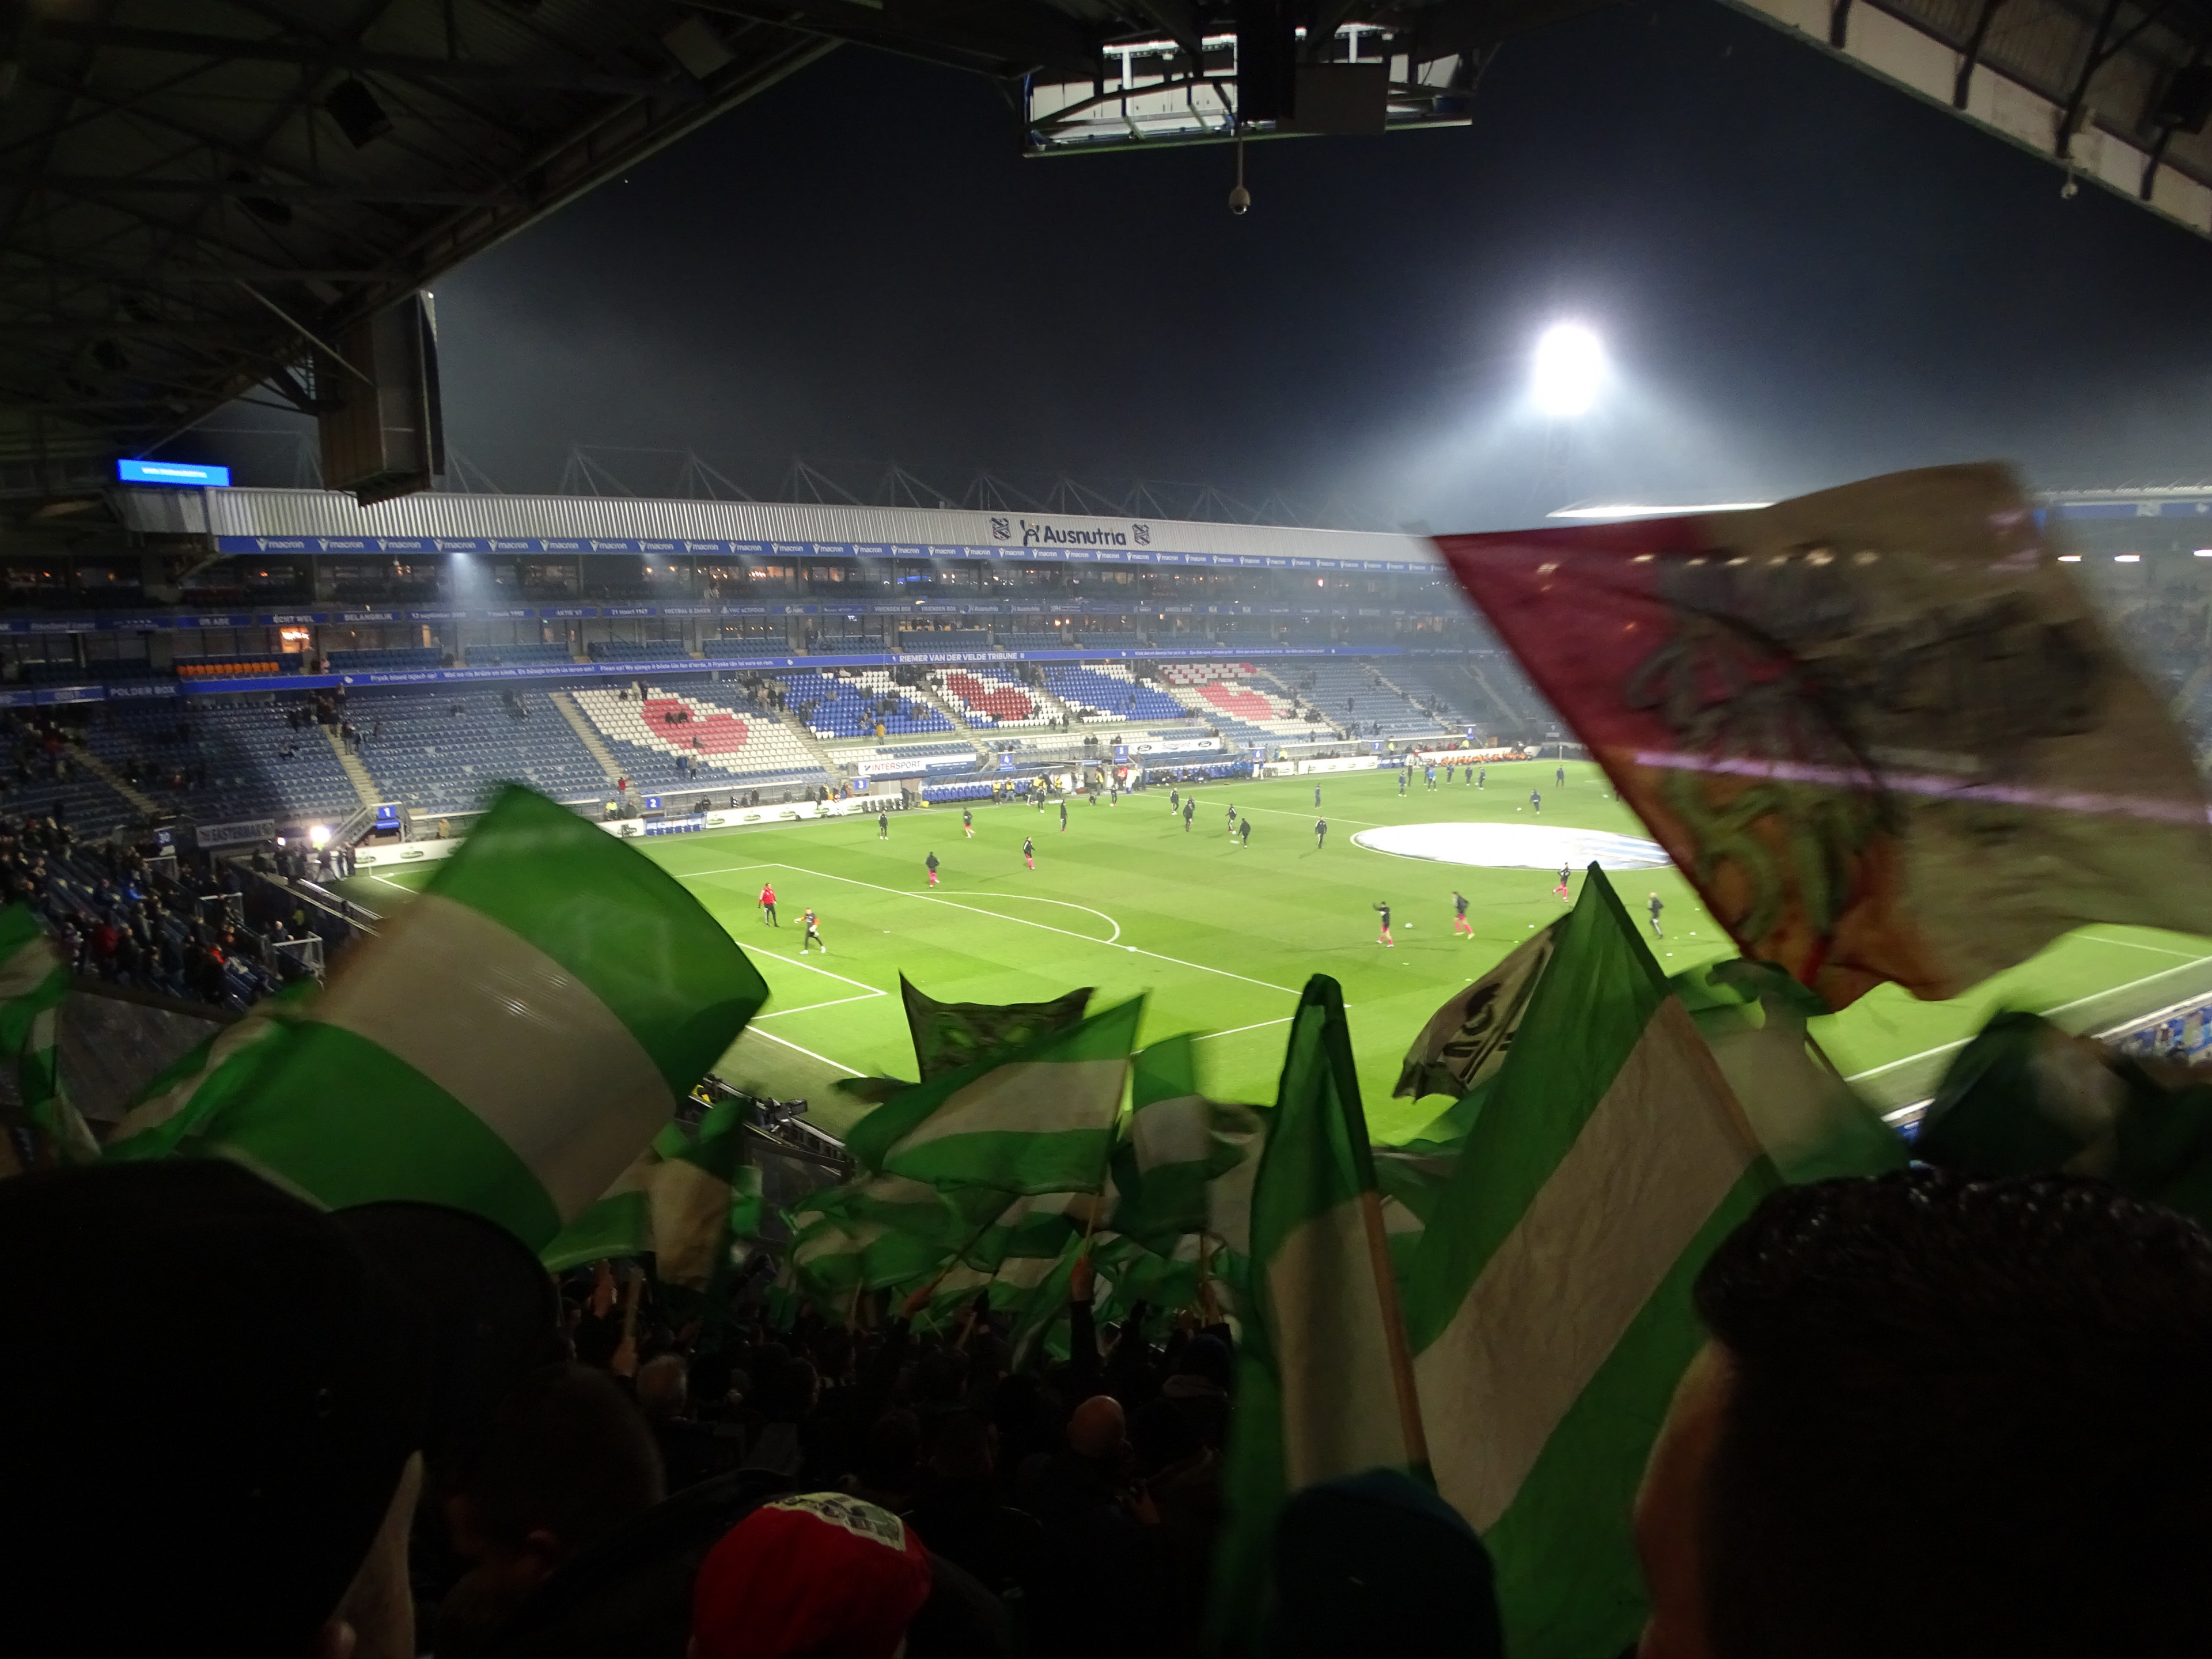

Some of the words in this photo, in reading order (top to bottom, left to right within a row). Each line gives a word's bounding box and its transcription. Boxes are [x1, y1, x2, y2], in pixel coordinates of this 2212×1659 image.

[1044, 525, 1127, 546] Ausnutria
[899, 654, 927, 662] RIEMER
[987, 652, 1017, 660] TRIBUNE
[110, 687, 152, 696] POLDER
[154, 685, 175, 695] BOX
[1004, 755, 1009, 763] 4
[872, 761, 921, 771] INTERSPORT
[650, 798, 657, 808] 2
[384, 807, 391, 817] 1
